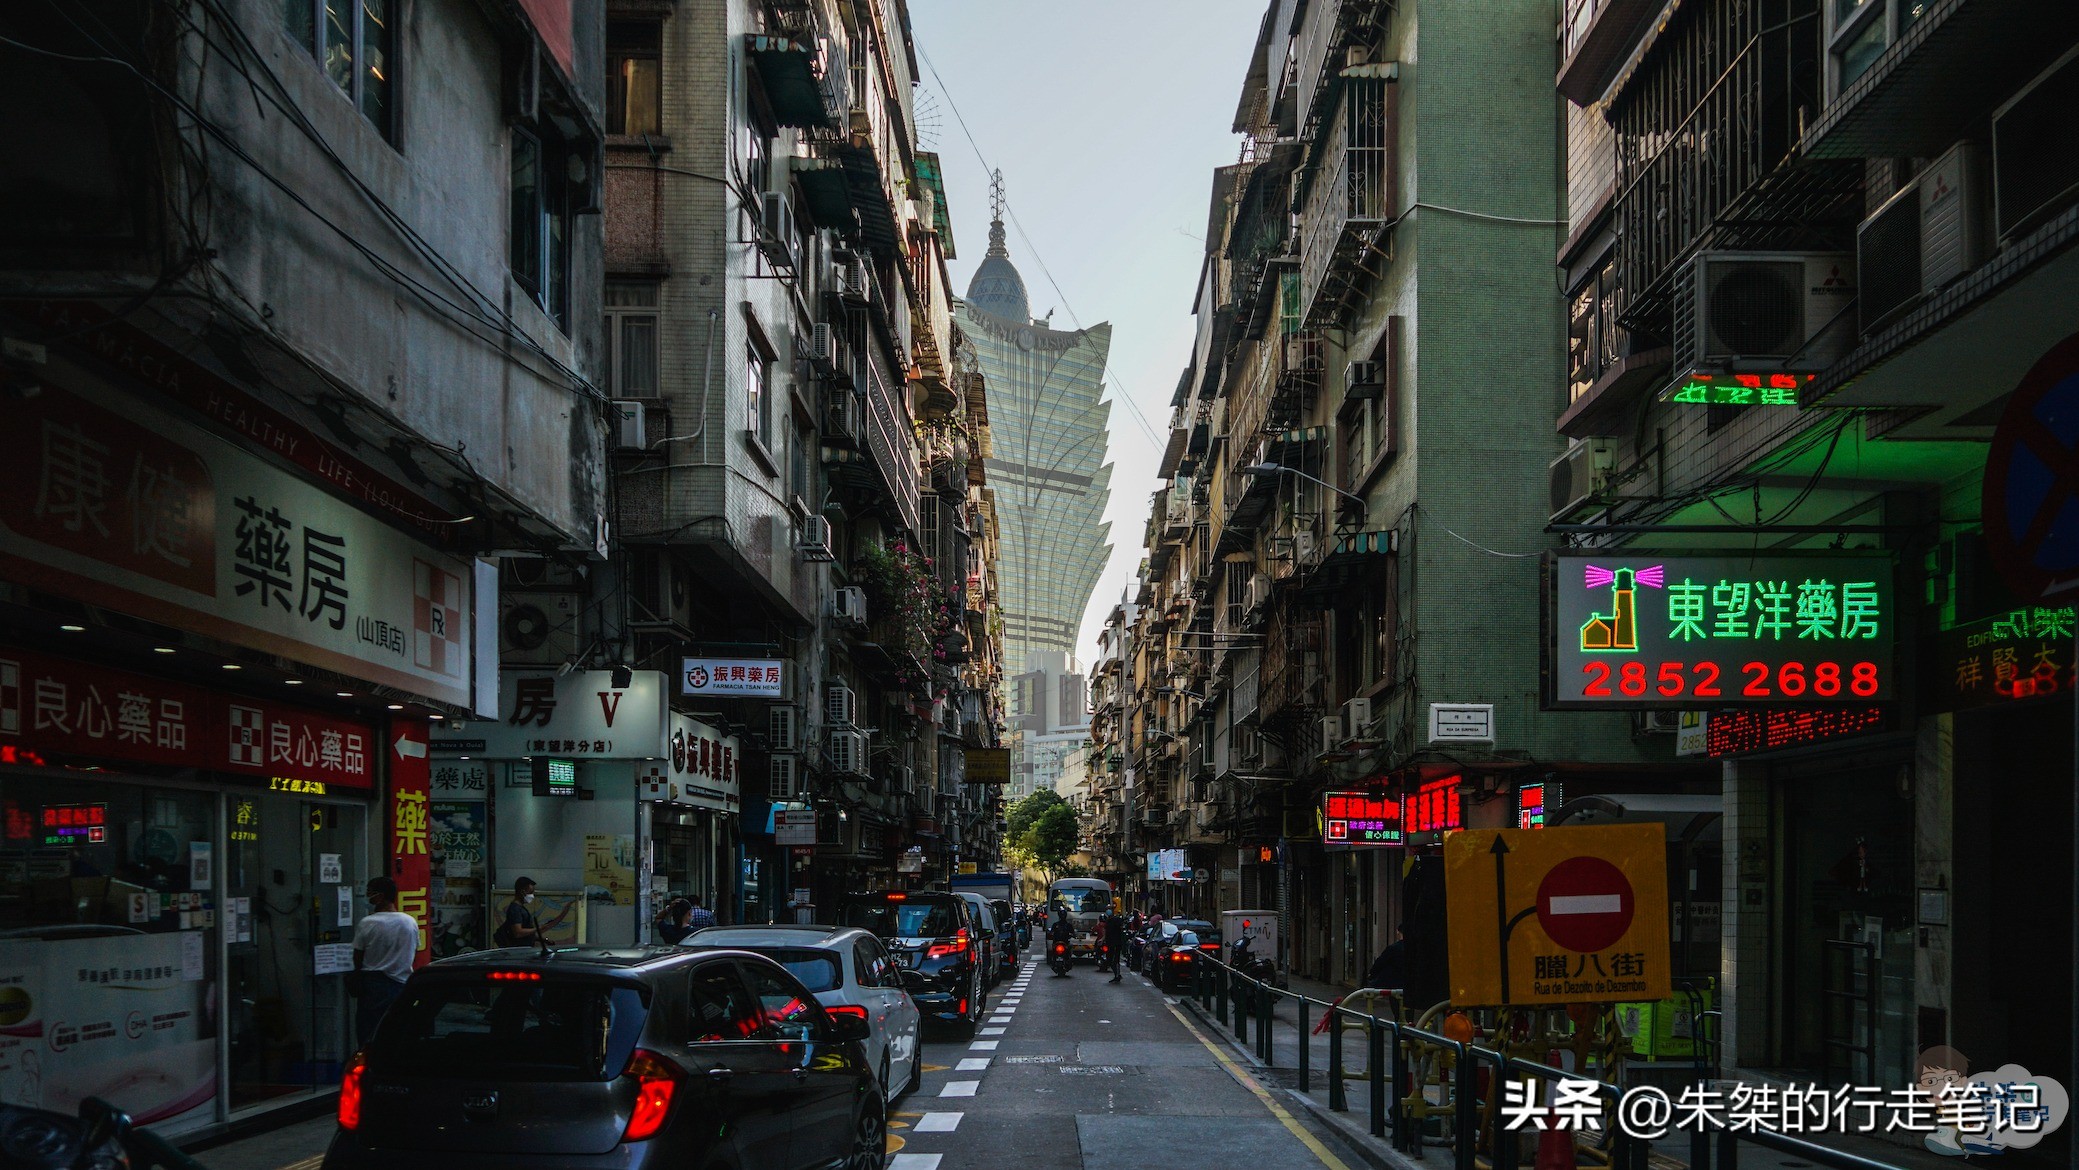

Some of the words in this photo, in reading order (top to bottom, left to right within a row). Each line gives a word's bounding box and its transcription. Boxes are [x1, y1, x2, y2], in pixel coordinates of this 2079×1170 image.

[206, 391, 300, 456] HEALTHY
[318, 454, 353, 487] LIFE
[233, 495, 350, 631] 藥房
[355, 617, 407, 658] (山頂店)
[1667, 578, 1880, 643] 東望洋藥房
[713, 666, 780, 683] 振興藥房
[1584, 661, 1721, 697] 2852
[1742, 661, 1879, 697] 2688
[33, 676, 187, 751] 良心藥品
[597, 692, 623, 728] V
[269, 720, 365, 775] 良心藥品
[526, 739, 613, 753] (東望洋分店)
[428, 767, 485, 790] 藥處
[1535, 953, 1645, 979] 臘八街
[1534, 981, 1549, 994] Rua
[1552, 981, 1561, 993] de
[1564, 980, 1592, 994] Dezoito
[1595, 980, 1604, 992] de
[1607, 979, 1646, 992] Dezembro
